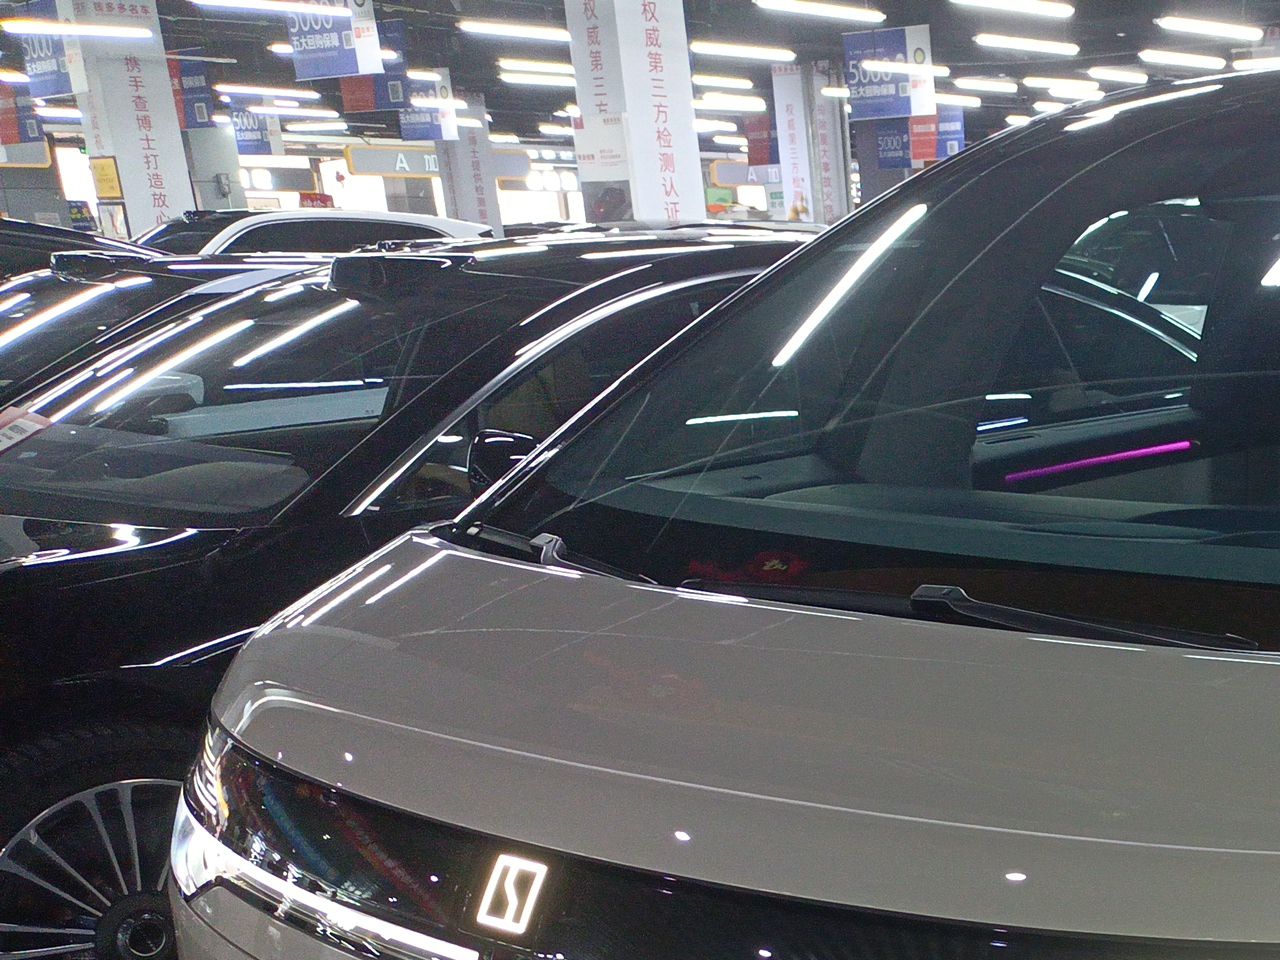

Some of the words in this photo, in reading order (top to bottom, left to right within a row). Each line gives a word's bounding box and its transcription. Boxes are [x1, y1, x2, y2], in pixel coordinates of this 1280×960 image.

[124, 55, 172, 225] 携手查博士打造放心
[232, 111, 258, 130] 5000
[641, 0, 681, 226] 权威第三方检测认证
[395, 153, 410, 172] A
